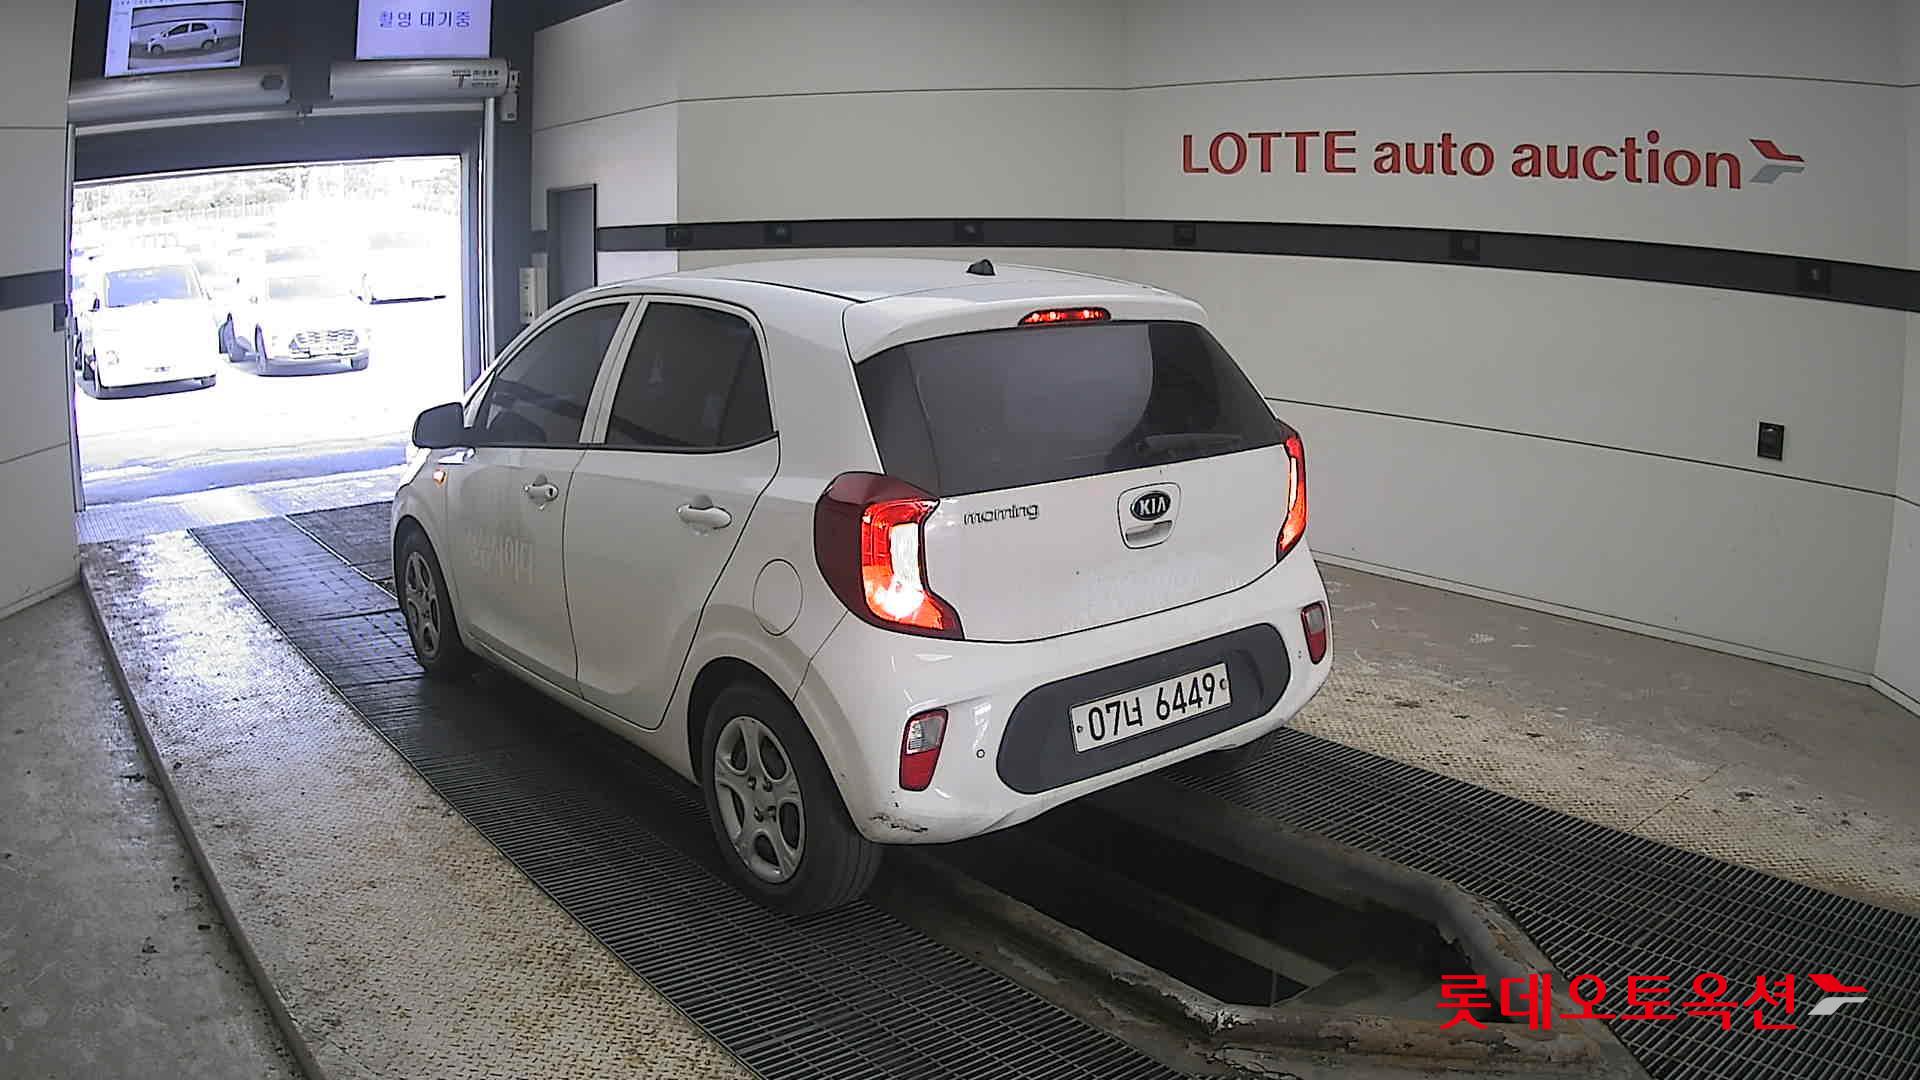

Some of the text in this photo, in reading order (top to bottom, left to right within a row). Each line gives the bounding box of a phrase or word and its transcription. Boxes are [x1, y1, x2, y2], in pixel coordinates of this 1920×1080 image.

[420, 11, 471, 28] 대기중
[1183, 130, 1742, 189] LOTTE auto auction
[1138, 498, 1167, 518] KIA
[1088, 673, 1216, 741] 07너 6449
